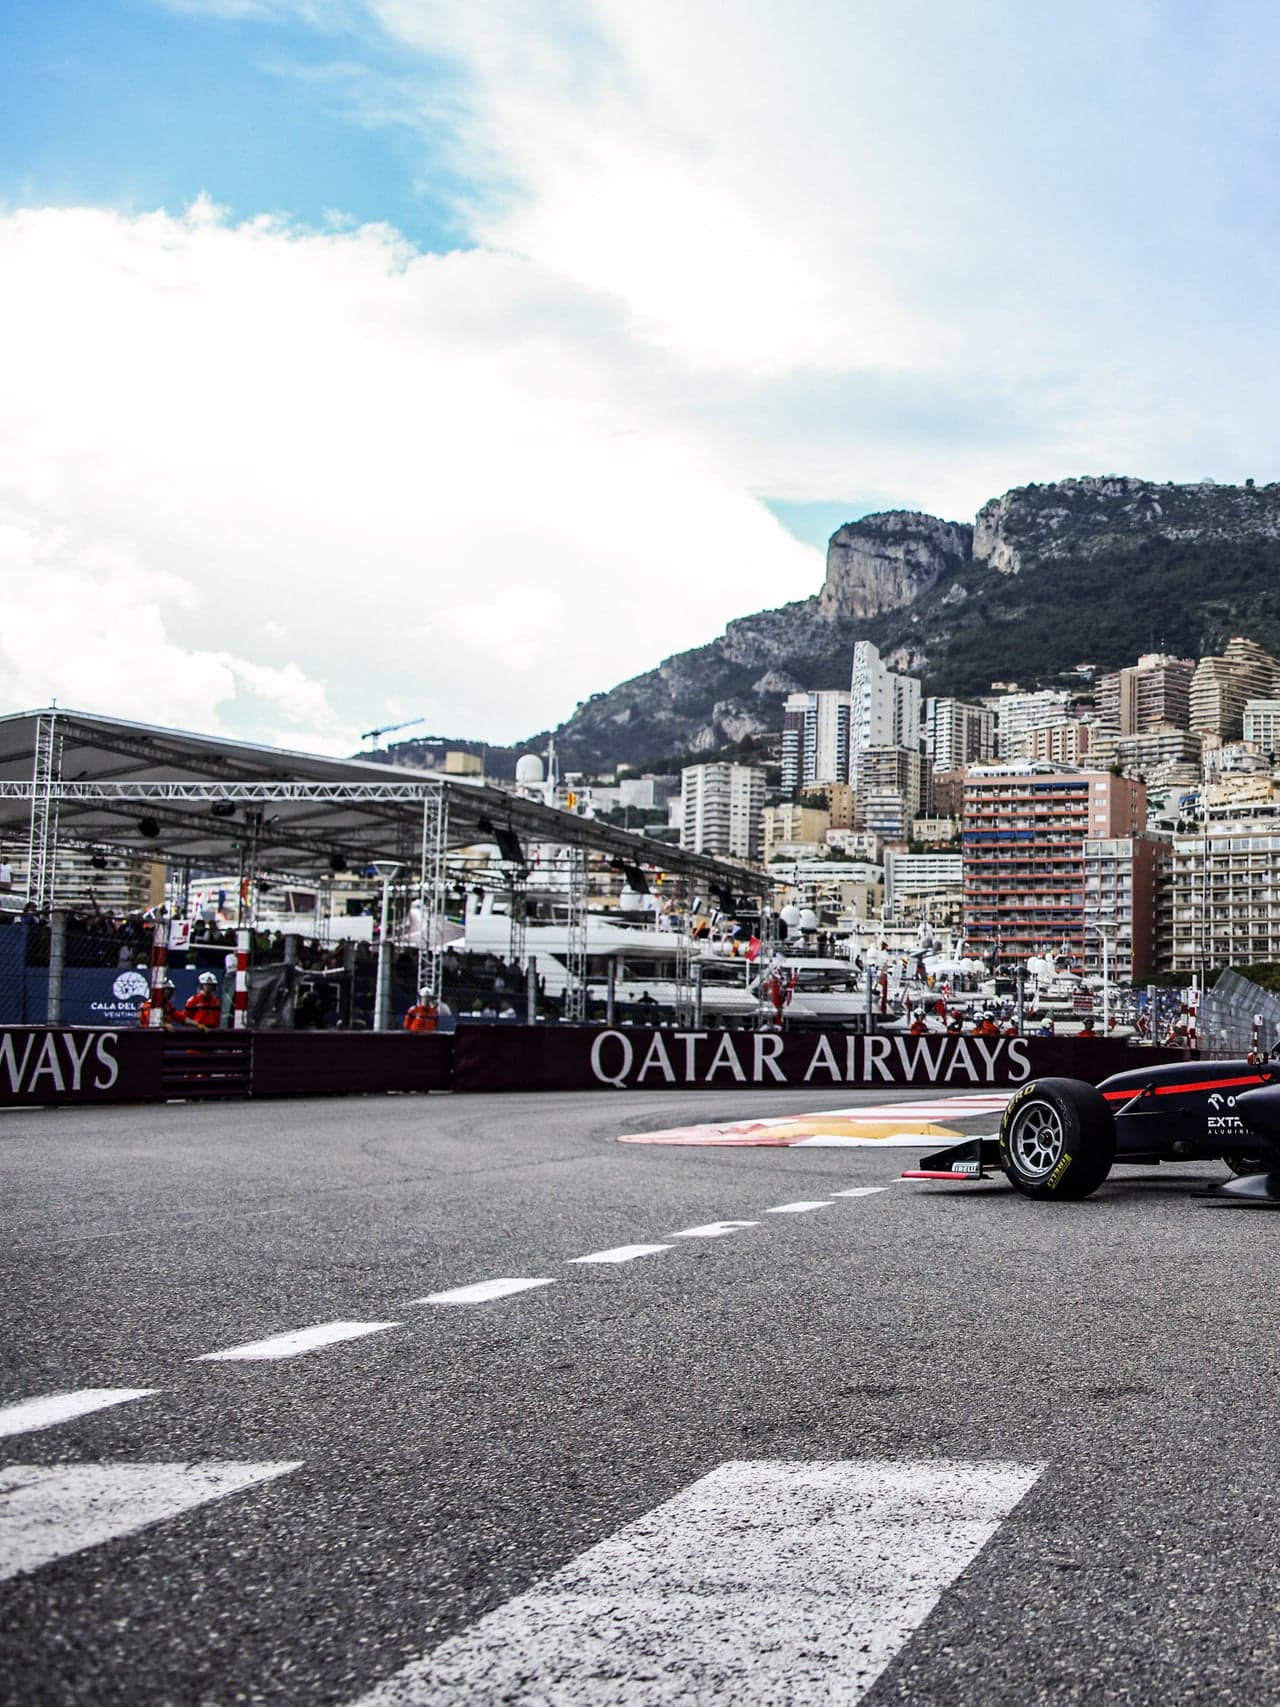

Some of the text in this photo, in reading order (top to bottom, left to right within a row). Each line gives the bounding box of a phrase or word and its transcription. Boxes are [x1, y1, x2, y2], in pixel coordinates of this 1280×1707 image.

[91, 1002, 137, 1010] CALA DEL
[590, 1029, 1032, 1088] QATAR AIRWAYS
